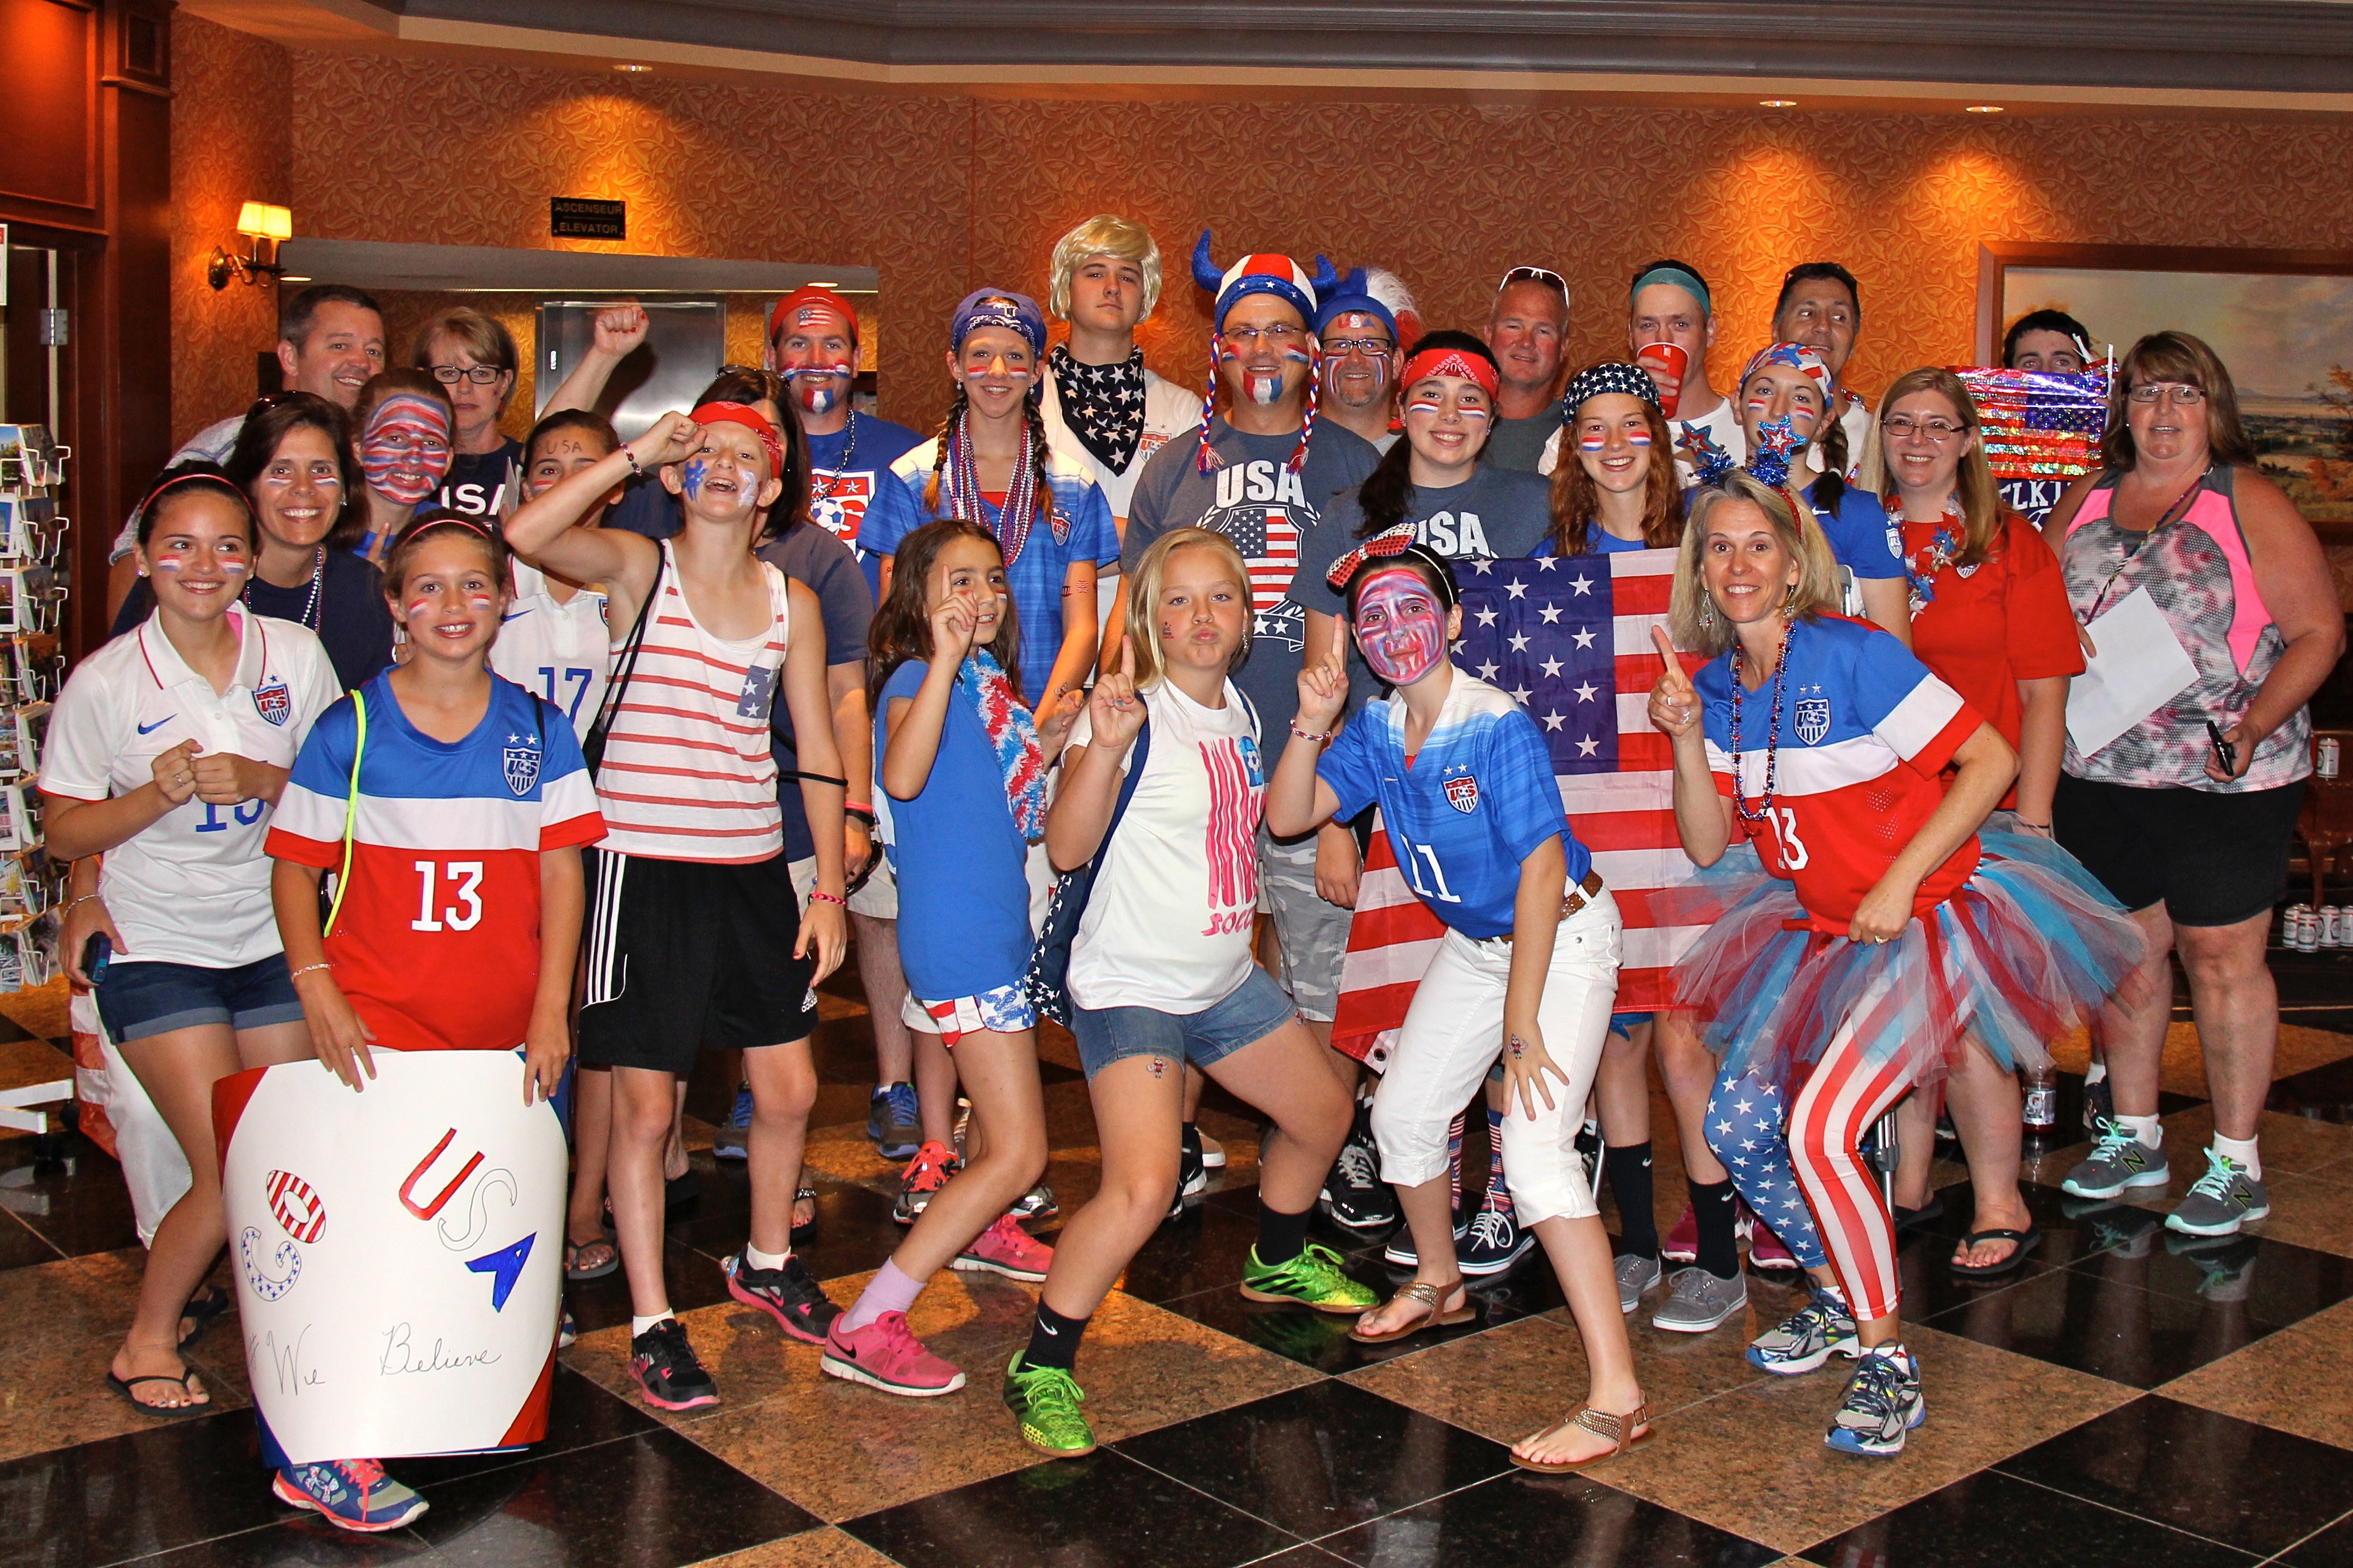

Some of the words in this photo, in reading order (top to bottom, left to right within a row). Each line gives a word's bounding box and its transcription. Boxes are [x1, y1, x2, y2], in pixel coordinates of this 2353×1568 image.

[554, 203, 622, 214] ASCENSEUR
[559, 223, 618, 233] ELEVATOR
[1338, 314, 1379, 330] USA
[546, 440, 582, 455] USA
[1216, 460, 1306, 508] USA
[538, 667, 592, 725] 17
[1400, 833, 1462, 903] 11
[411, 860, 483, 932] 13
[398, 1127, 537, 1313] USA
[380, 1322, 502, 1376] Believe
